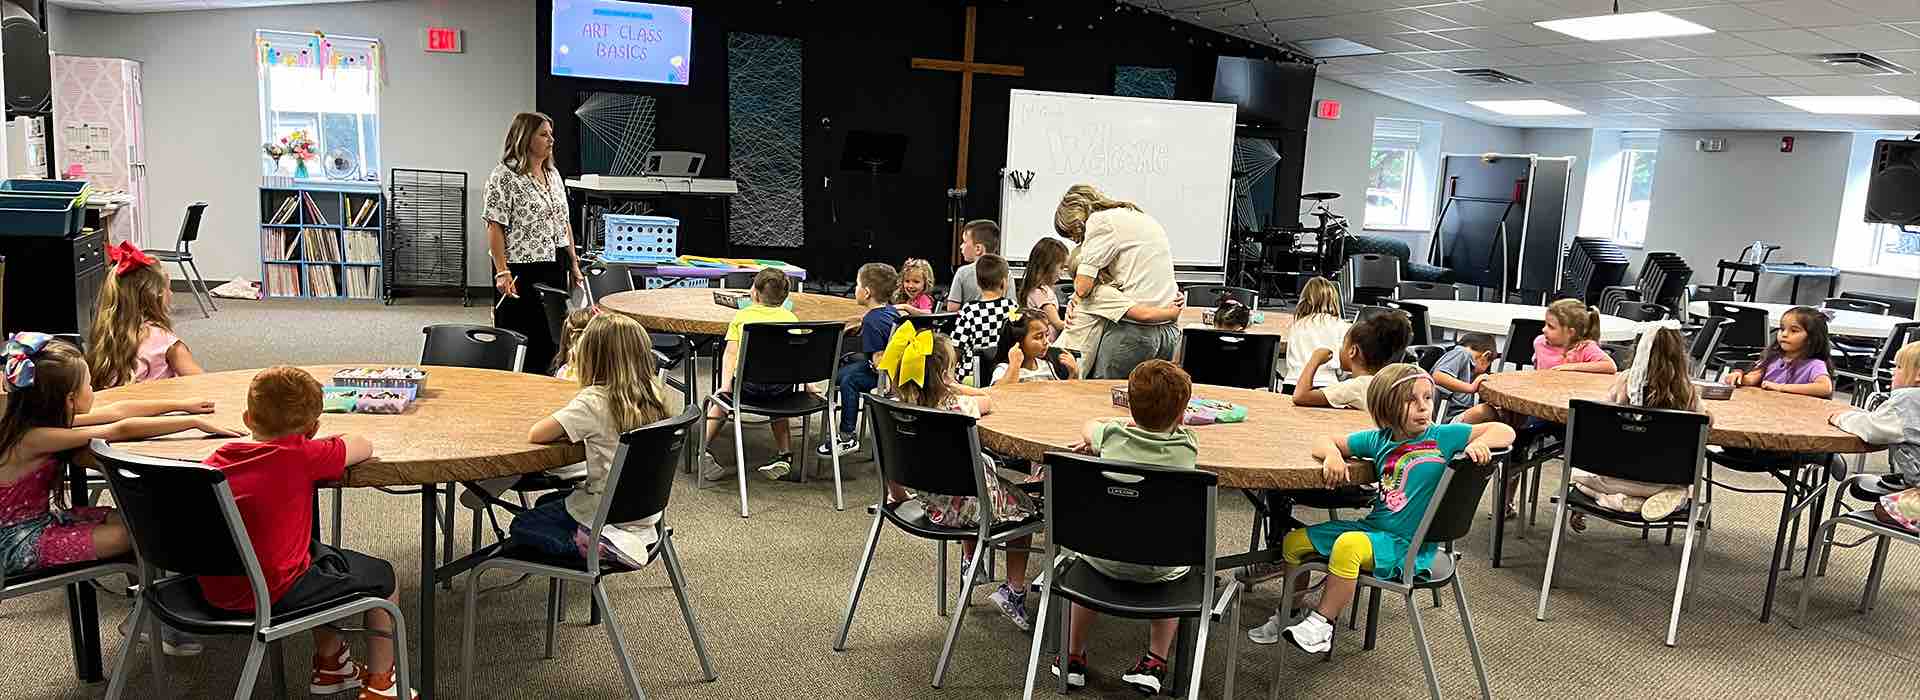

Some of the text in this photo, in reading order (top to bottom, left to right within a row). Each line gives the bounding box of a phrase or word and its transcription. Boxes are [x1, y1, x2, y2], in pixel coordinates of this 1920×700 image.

[583, 23, 664, 42] ART CLASS
[596, 43, 648, 60] BASICS
